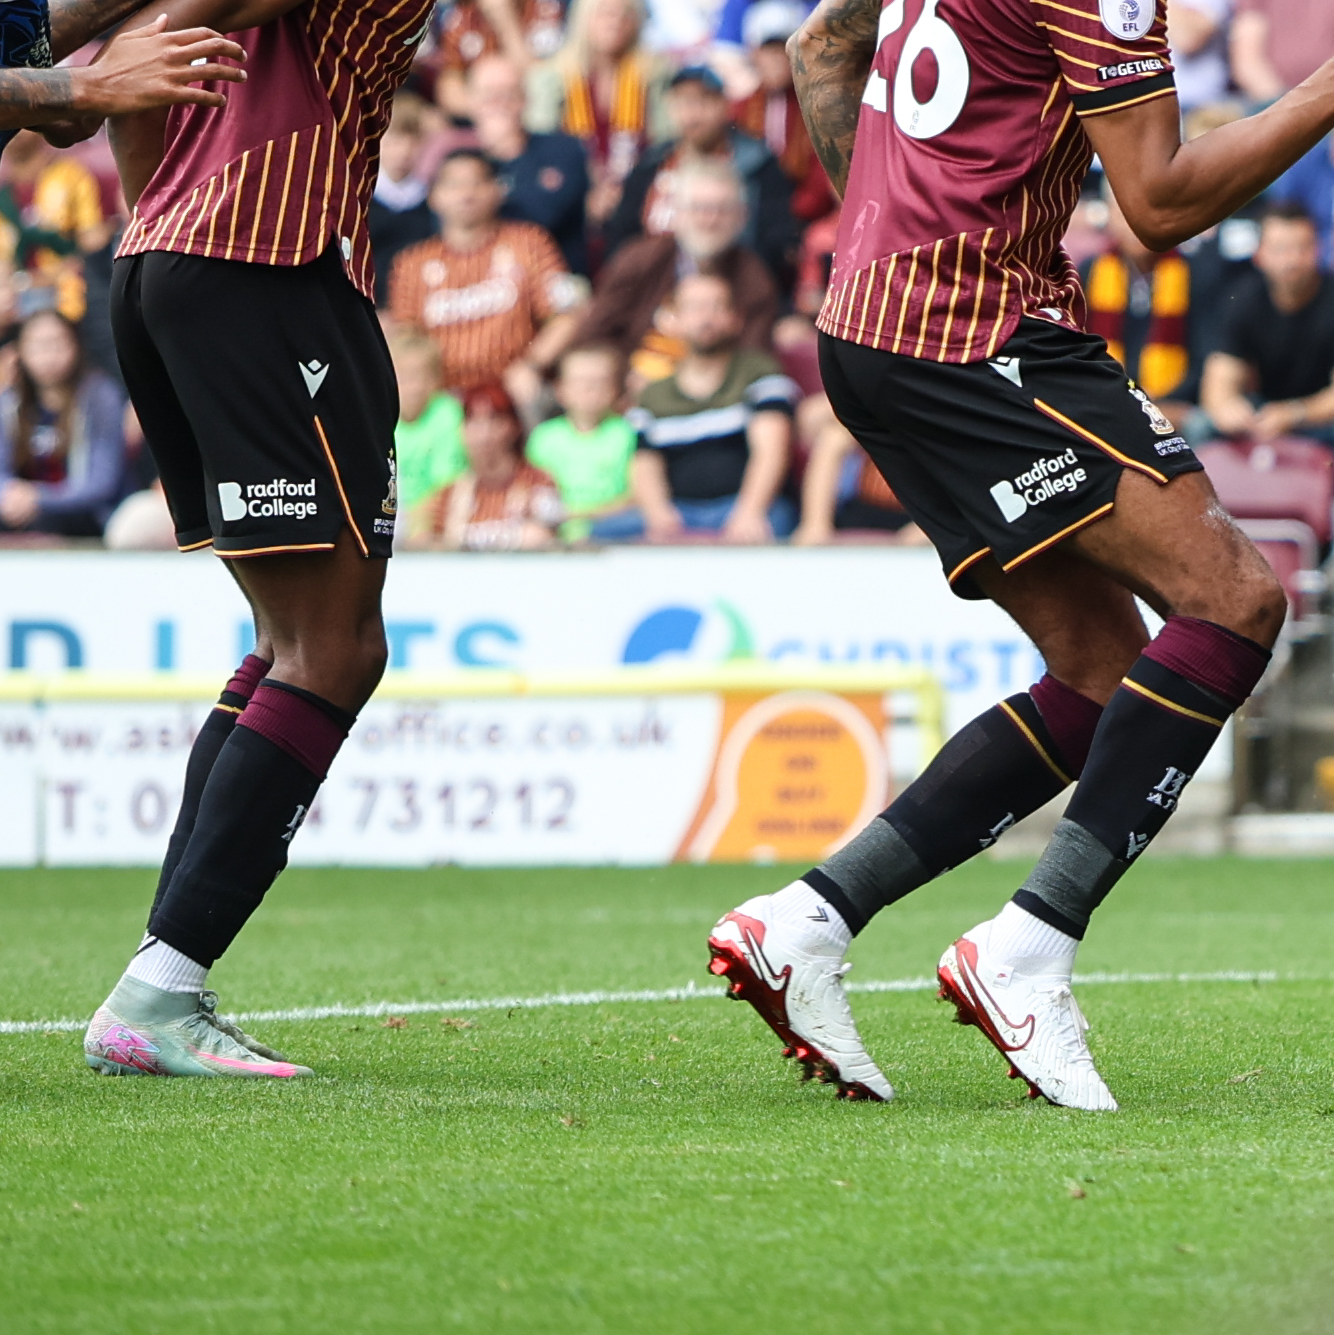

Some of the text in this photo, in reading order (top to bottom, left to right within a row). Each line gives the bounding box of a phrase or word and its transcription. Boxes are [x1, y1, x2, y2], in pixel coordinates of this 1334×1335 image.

[1122, 23, 1139, 32] EFL
[1099, 58, 1164, 80] TOGETHER
[1024, 468, 1087, 506] College
[248, 498, 318, 521] College
[351, 779, 577, 835] 731212
